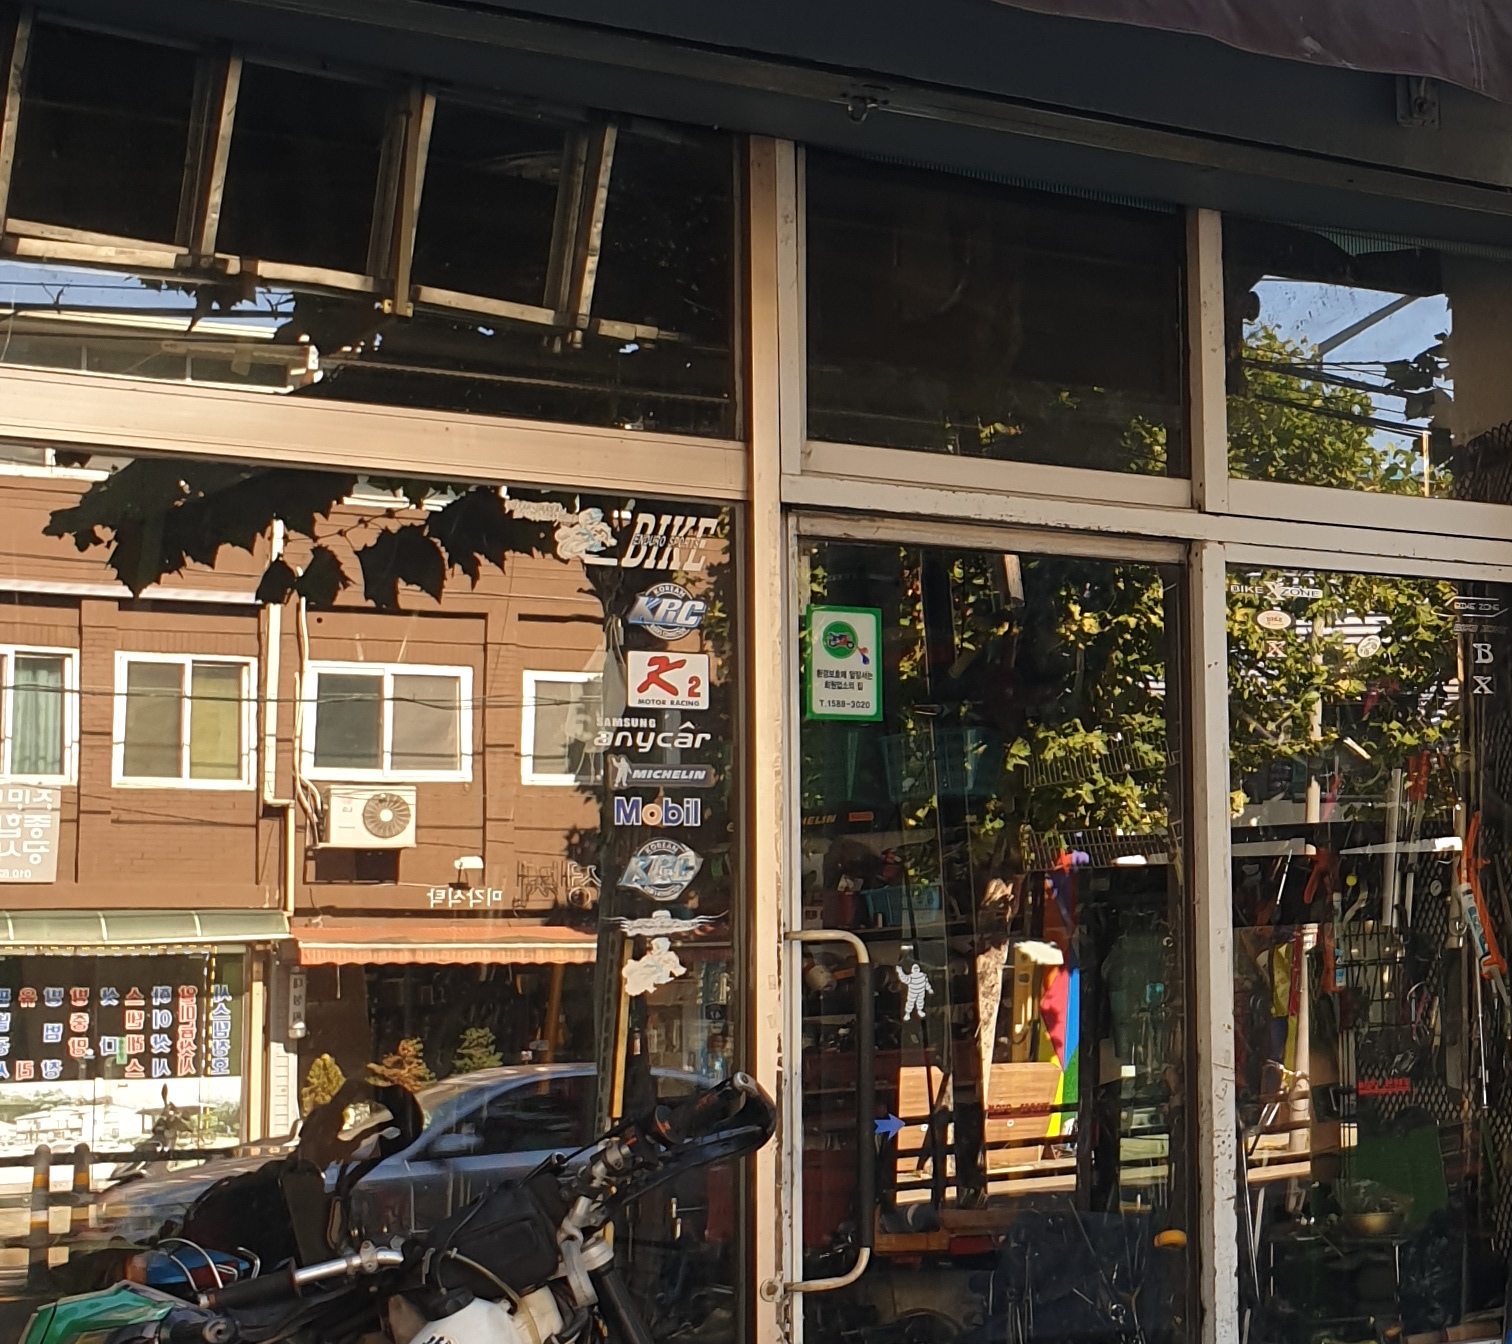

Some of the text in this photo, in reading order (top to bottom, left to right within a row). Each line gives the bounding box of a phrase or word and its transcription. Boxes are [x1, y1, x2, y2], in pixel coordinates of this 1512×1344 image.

[621, 512, 718, 572] BIKE
[1230, 584, 1265, 595] BIKE
[638, 698, 700, 707] MOTOR RACING
[596, 717, 657, 728] SAMSUNG
[632, 769, 707, 780] MICHELIN
[613, 796, 702, 827] Mobil
